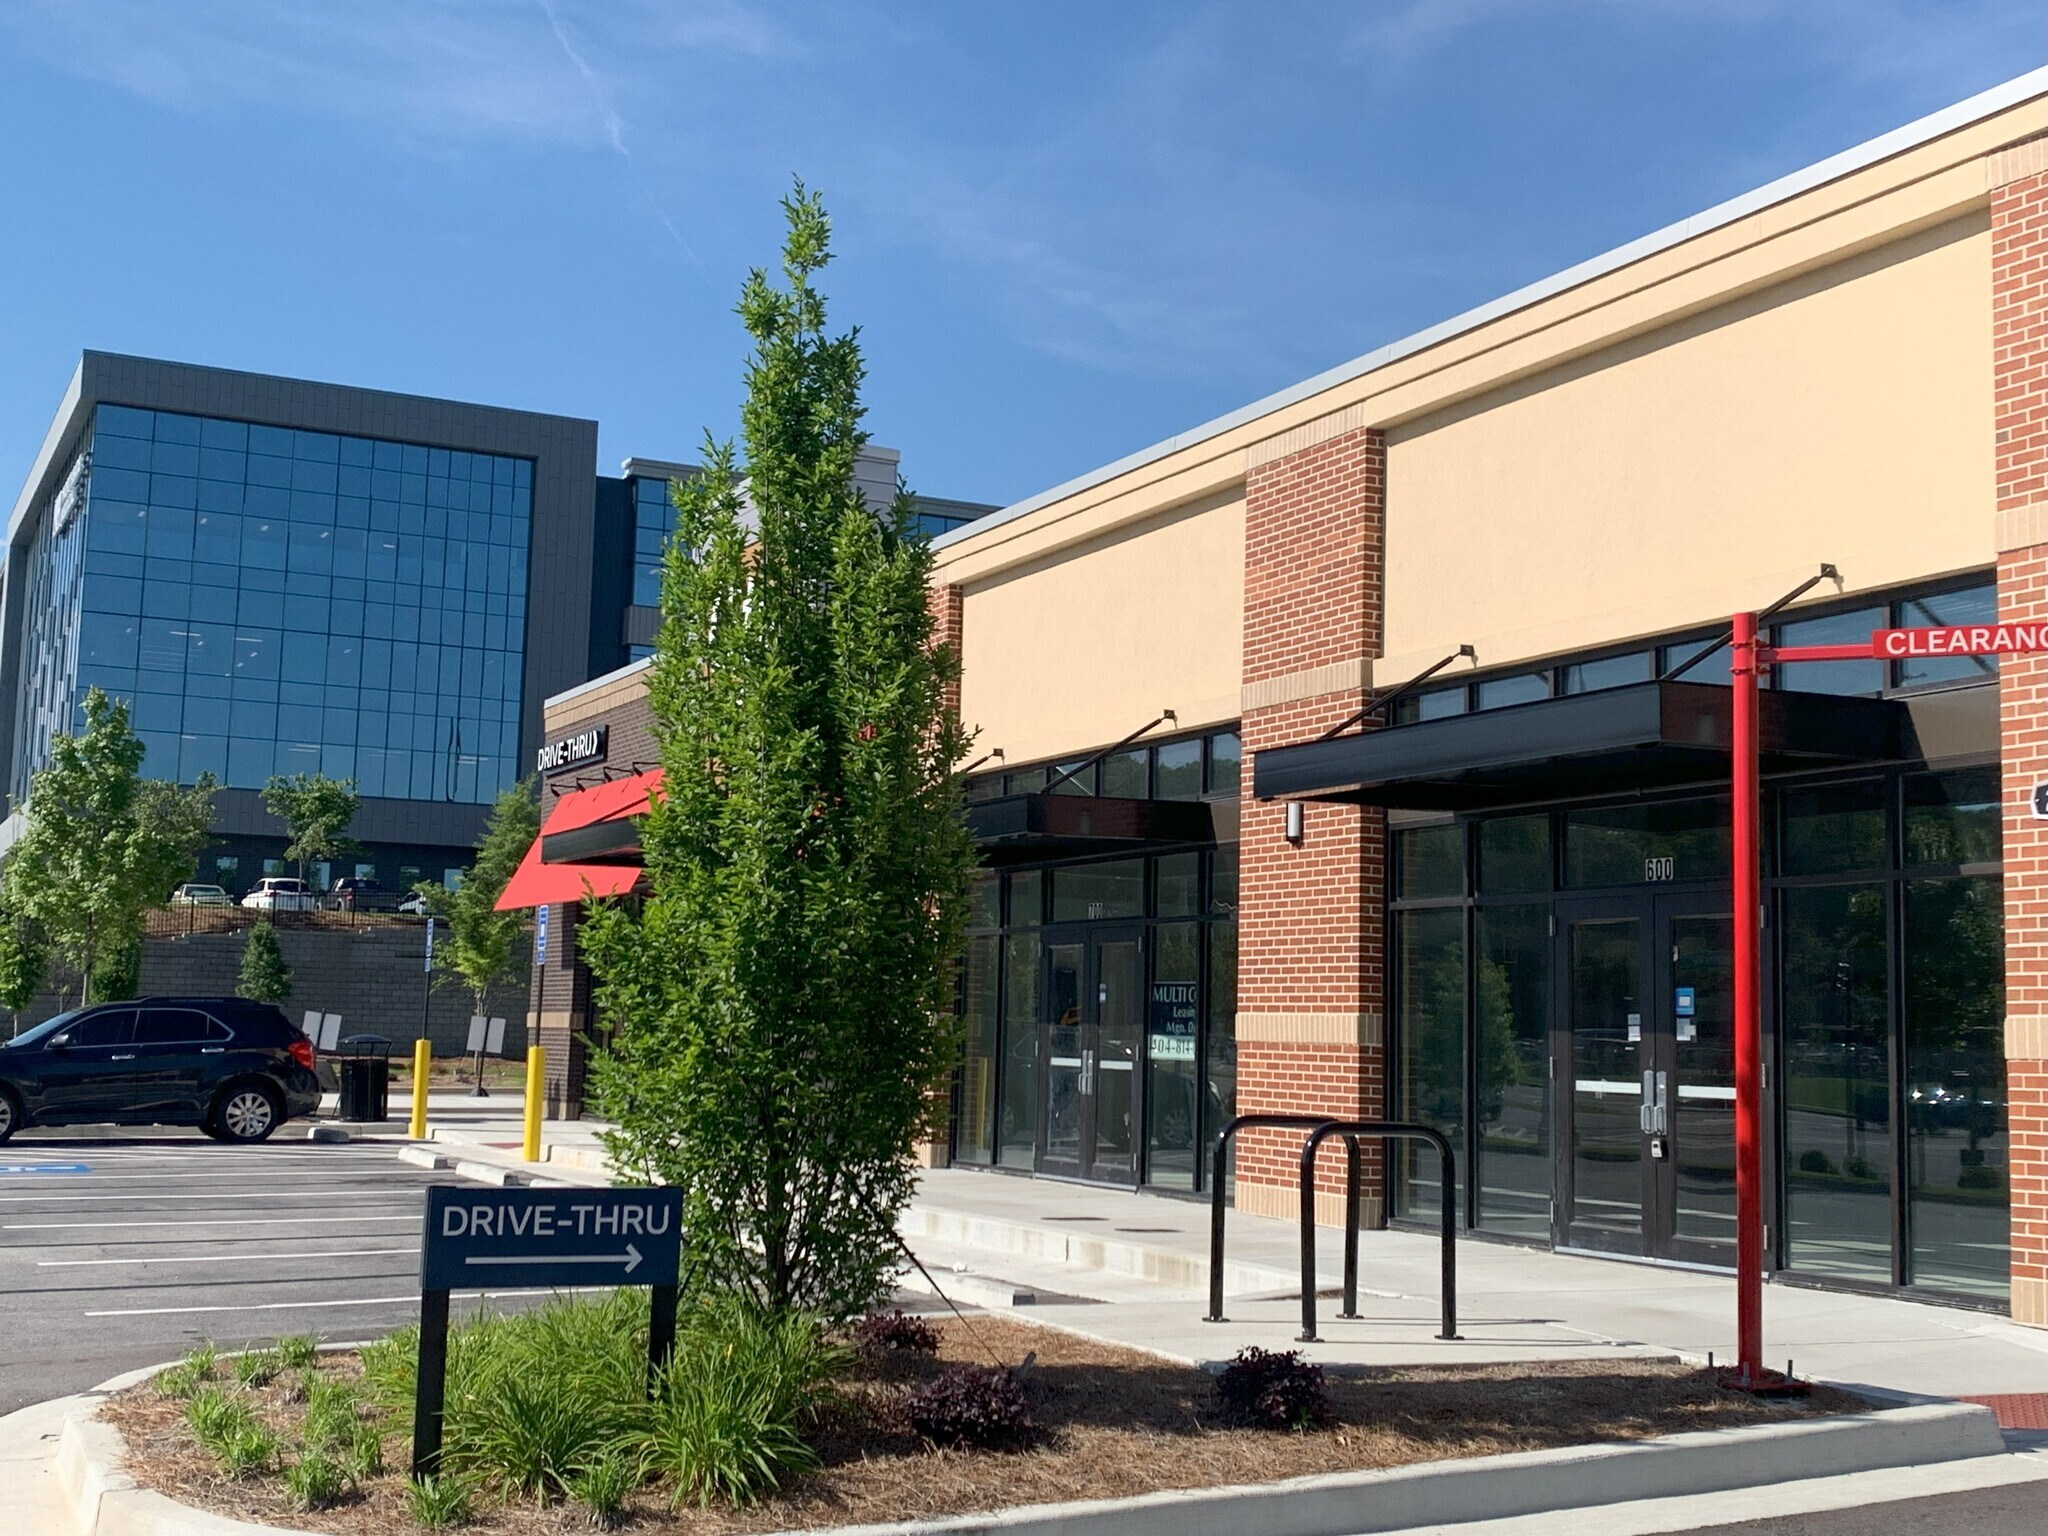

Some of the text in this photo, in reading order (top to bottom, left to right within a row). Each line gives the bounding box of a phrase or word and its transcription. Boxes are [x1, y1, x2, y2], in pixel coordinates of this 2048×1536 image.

[537, 731, 593, 771] DRIVE-THRU
[1647, 858, 1672, 881] 600
[442, 1204, 670, 1237] DRIVE-THRU
